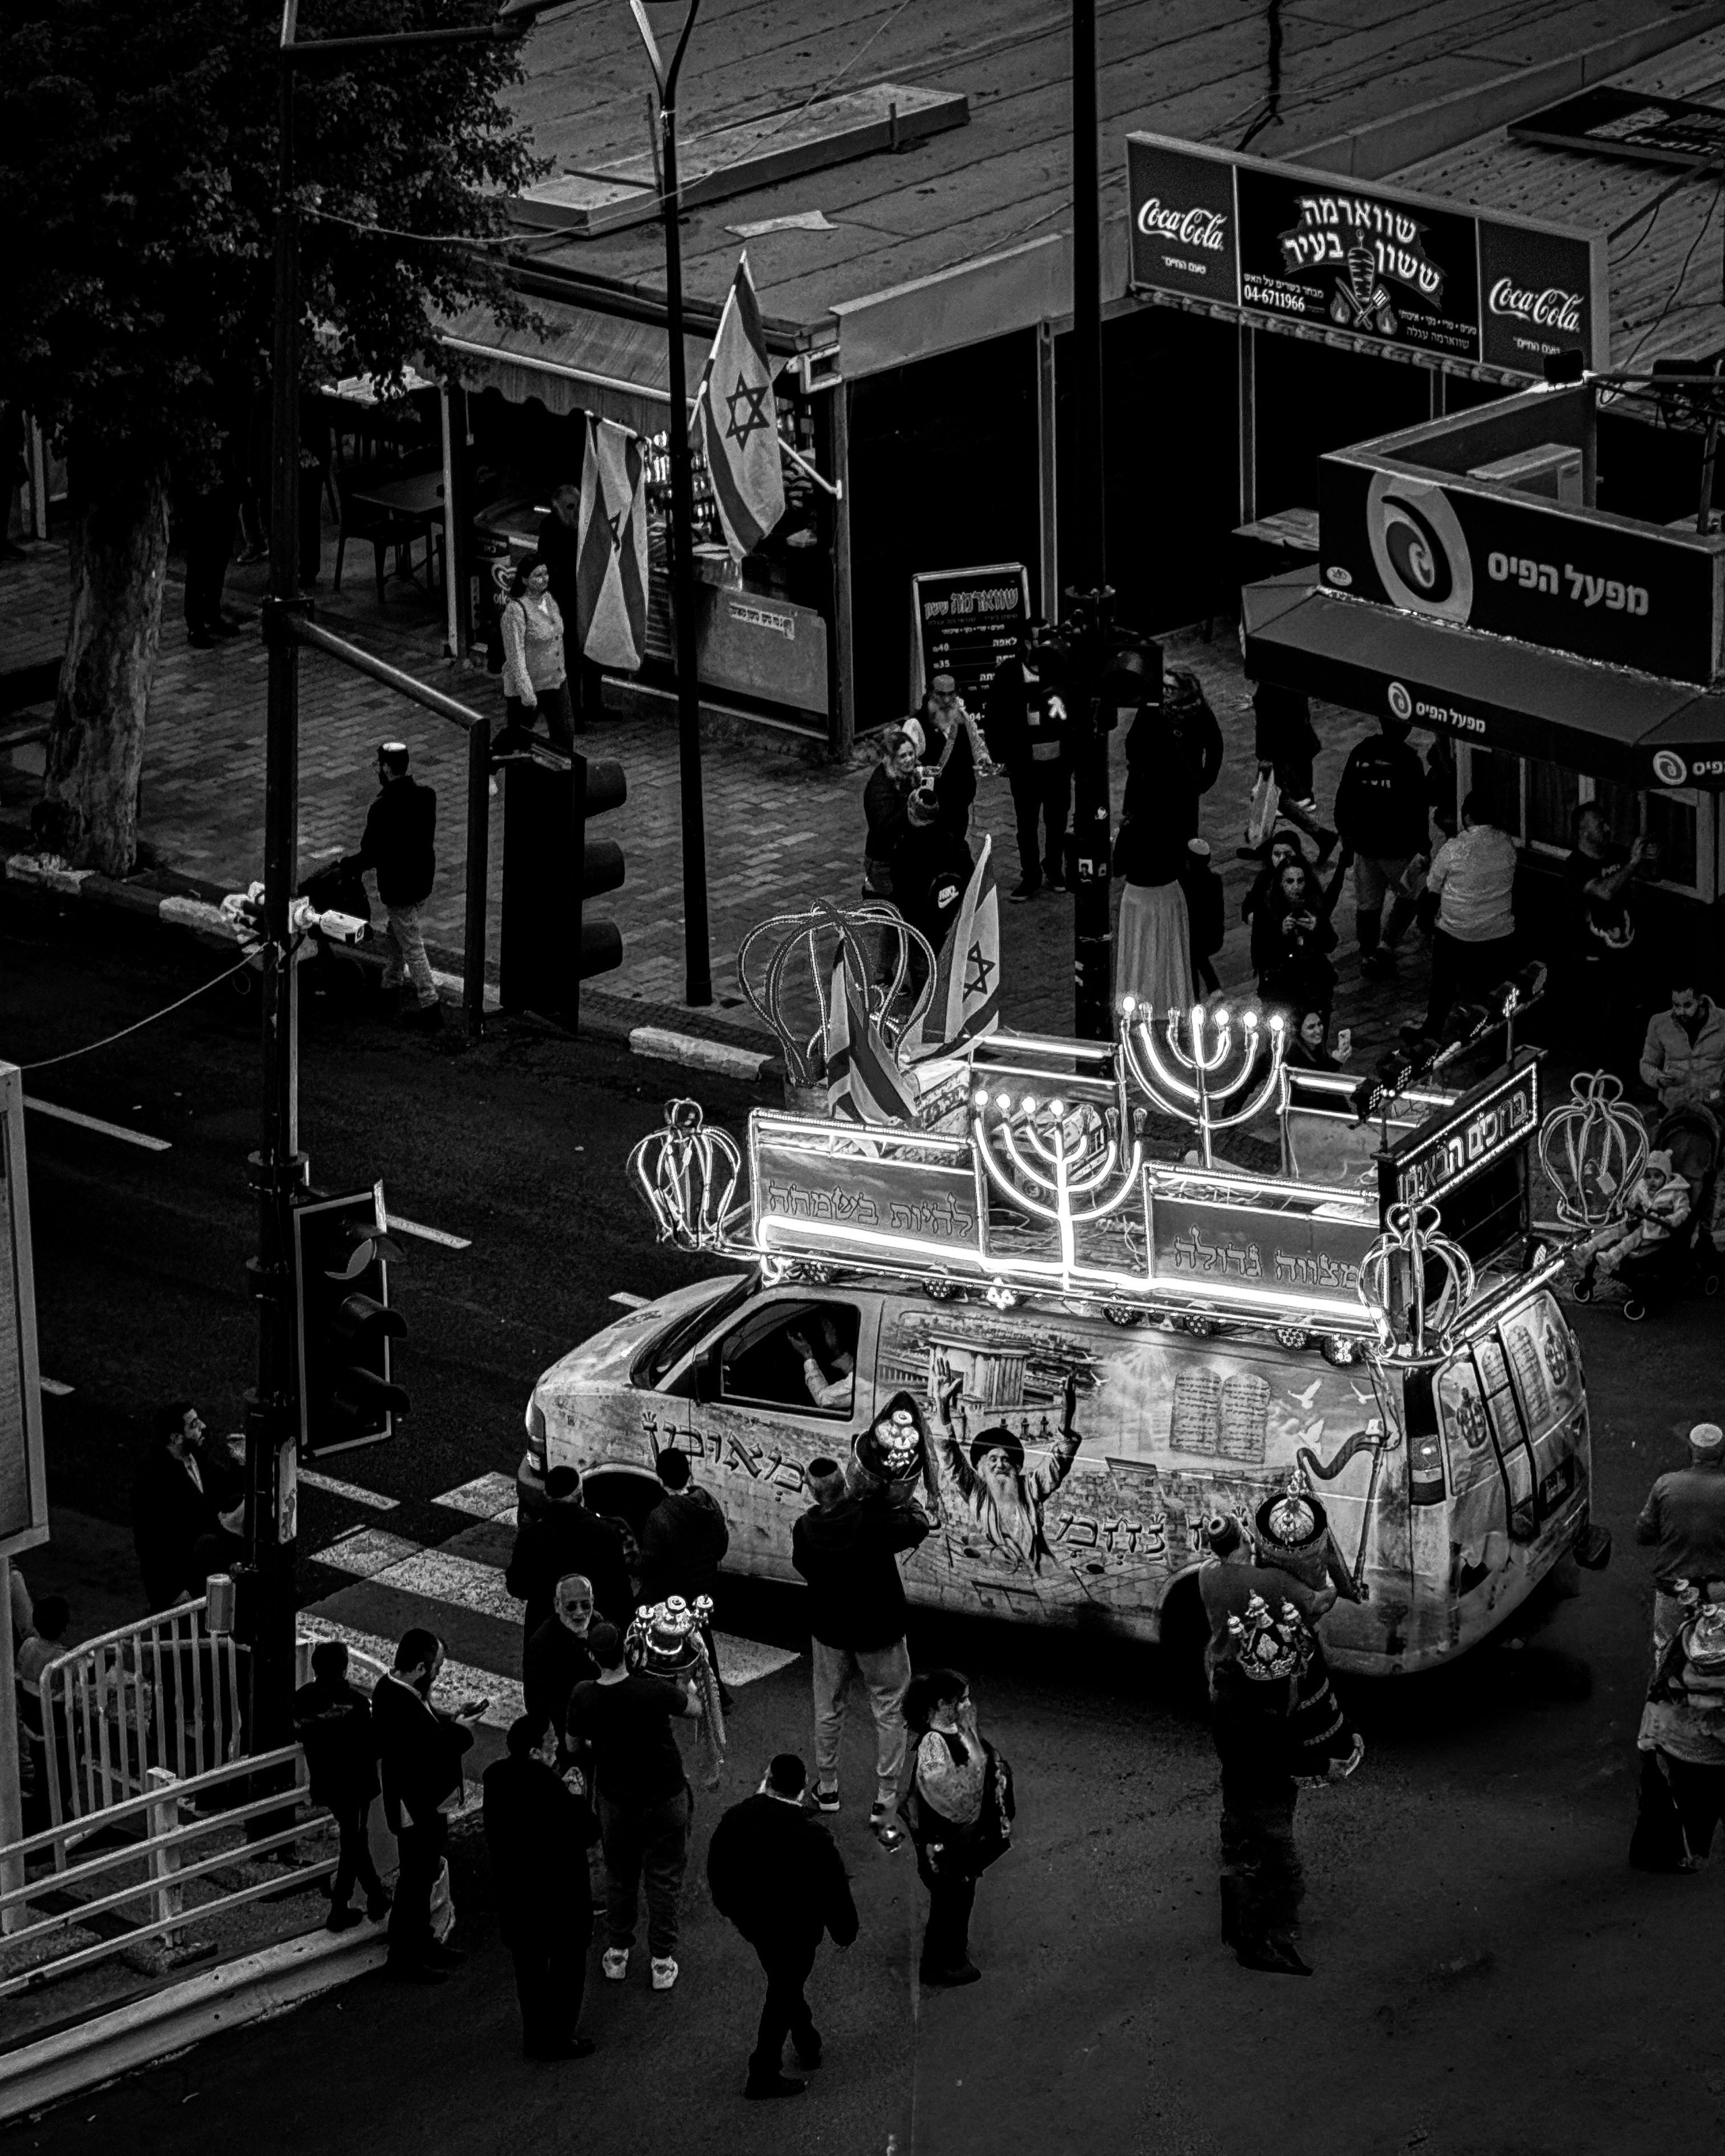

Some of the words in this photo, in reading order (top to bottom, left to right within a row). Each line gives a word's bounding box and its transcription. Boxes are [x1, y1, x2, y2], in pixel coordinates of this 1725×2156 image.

[1137, 197, 1228, 251] Coca-Cola
[1301, 197, 1416, 244] שווארמה
[1284, 230, 1344, 264] בעיר
[1374, 239, 1440, 292] ששון
[1243, 284, 1306, 313] 04-6711966
[1261, 274, 1274, 286] על
[1488, 277, 1585, 332] Coca-Cola
[1431, 332, 1470, 349] שווארמה
[1487, 551, 1559, 596] הפיס
[1563, 563, 1649, 616] מפעל
[950, 587, 1018, 615] שווארמה
[1415, 701, 1447, 723] הפיס
[1449, 708, 1486, 734] מפעל
[1692, 760, 1725, 777] פיס
[1466, 1090, 1529, 1161] ברוכים
[768, 1180, 879, 1226] בשמחה
[889, 1192, 974, 1238] להיות
[1174, 1225, 1263, 1277] גדולה
[1273, 1249, 1360, 1290] מצווה
